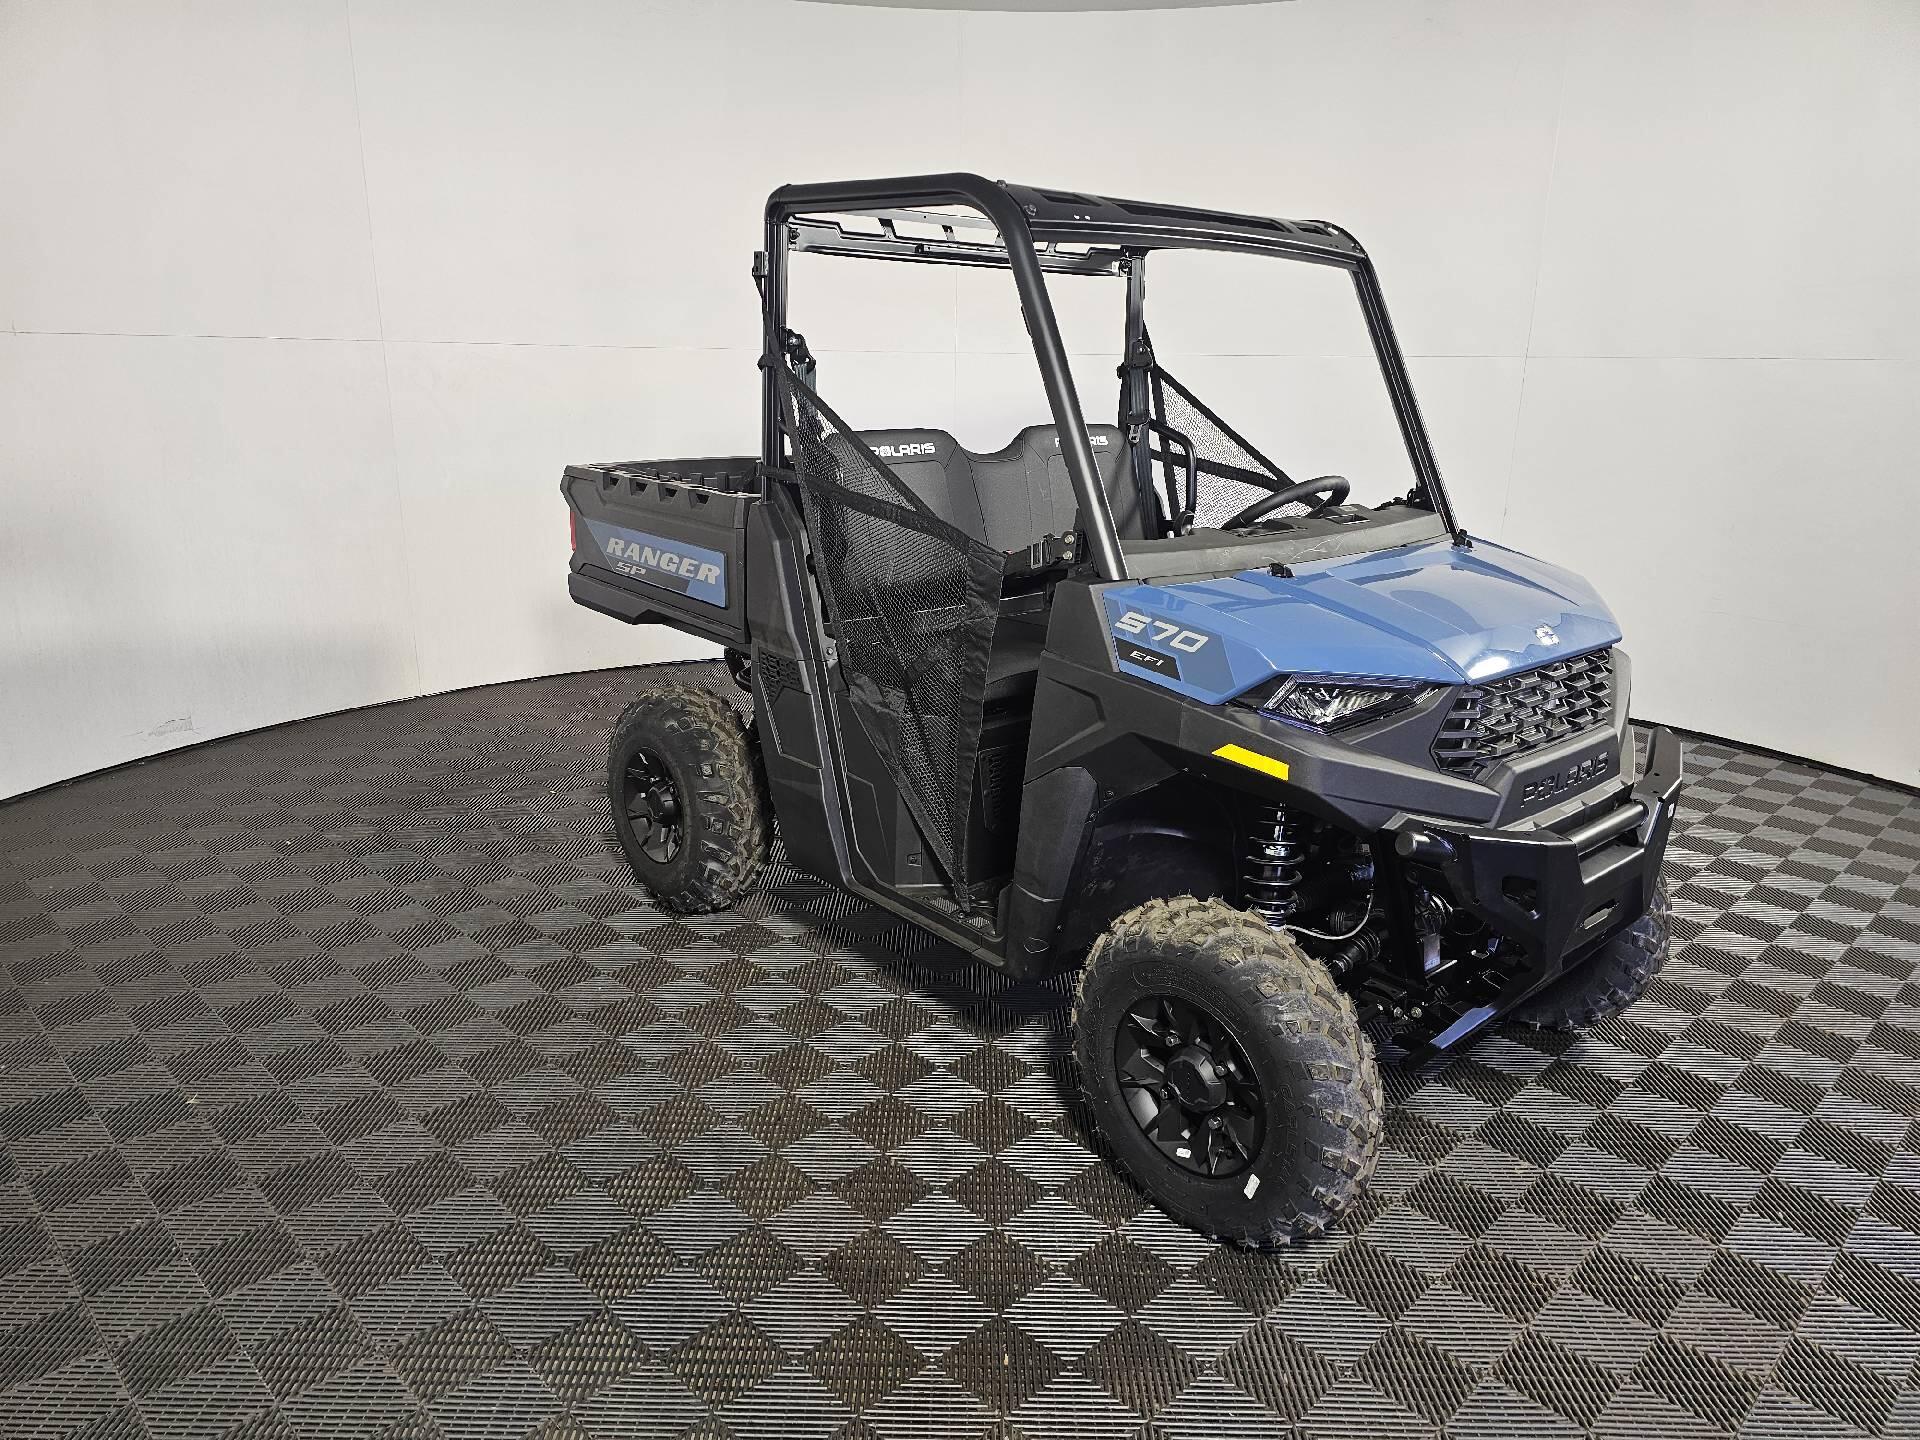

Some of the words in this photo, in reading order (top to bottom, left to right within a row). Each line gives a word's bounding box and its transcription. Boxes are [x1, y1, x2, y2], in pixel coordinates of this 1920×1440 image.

[606, 538, 721, 585] RANGER
[615, 561, 647, 575] SP
[1114, 611, 1209, 653] 570
[1129, 650, 1164, 667] EFI
[1521, 751, 1609, 808] POLARIS
